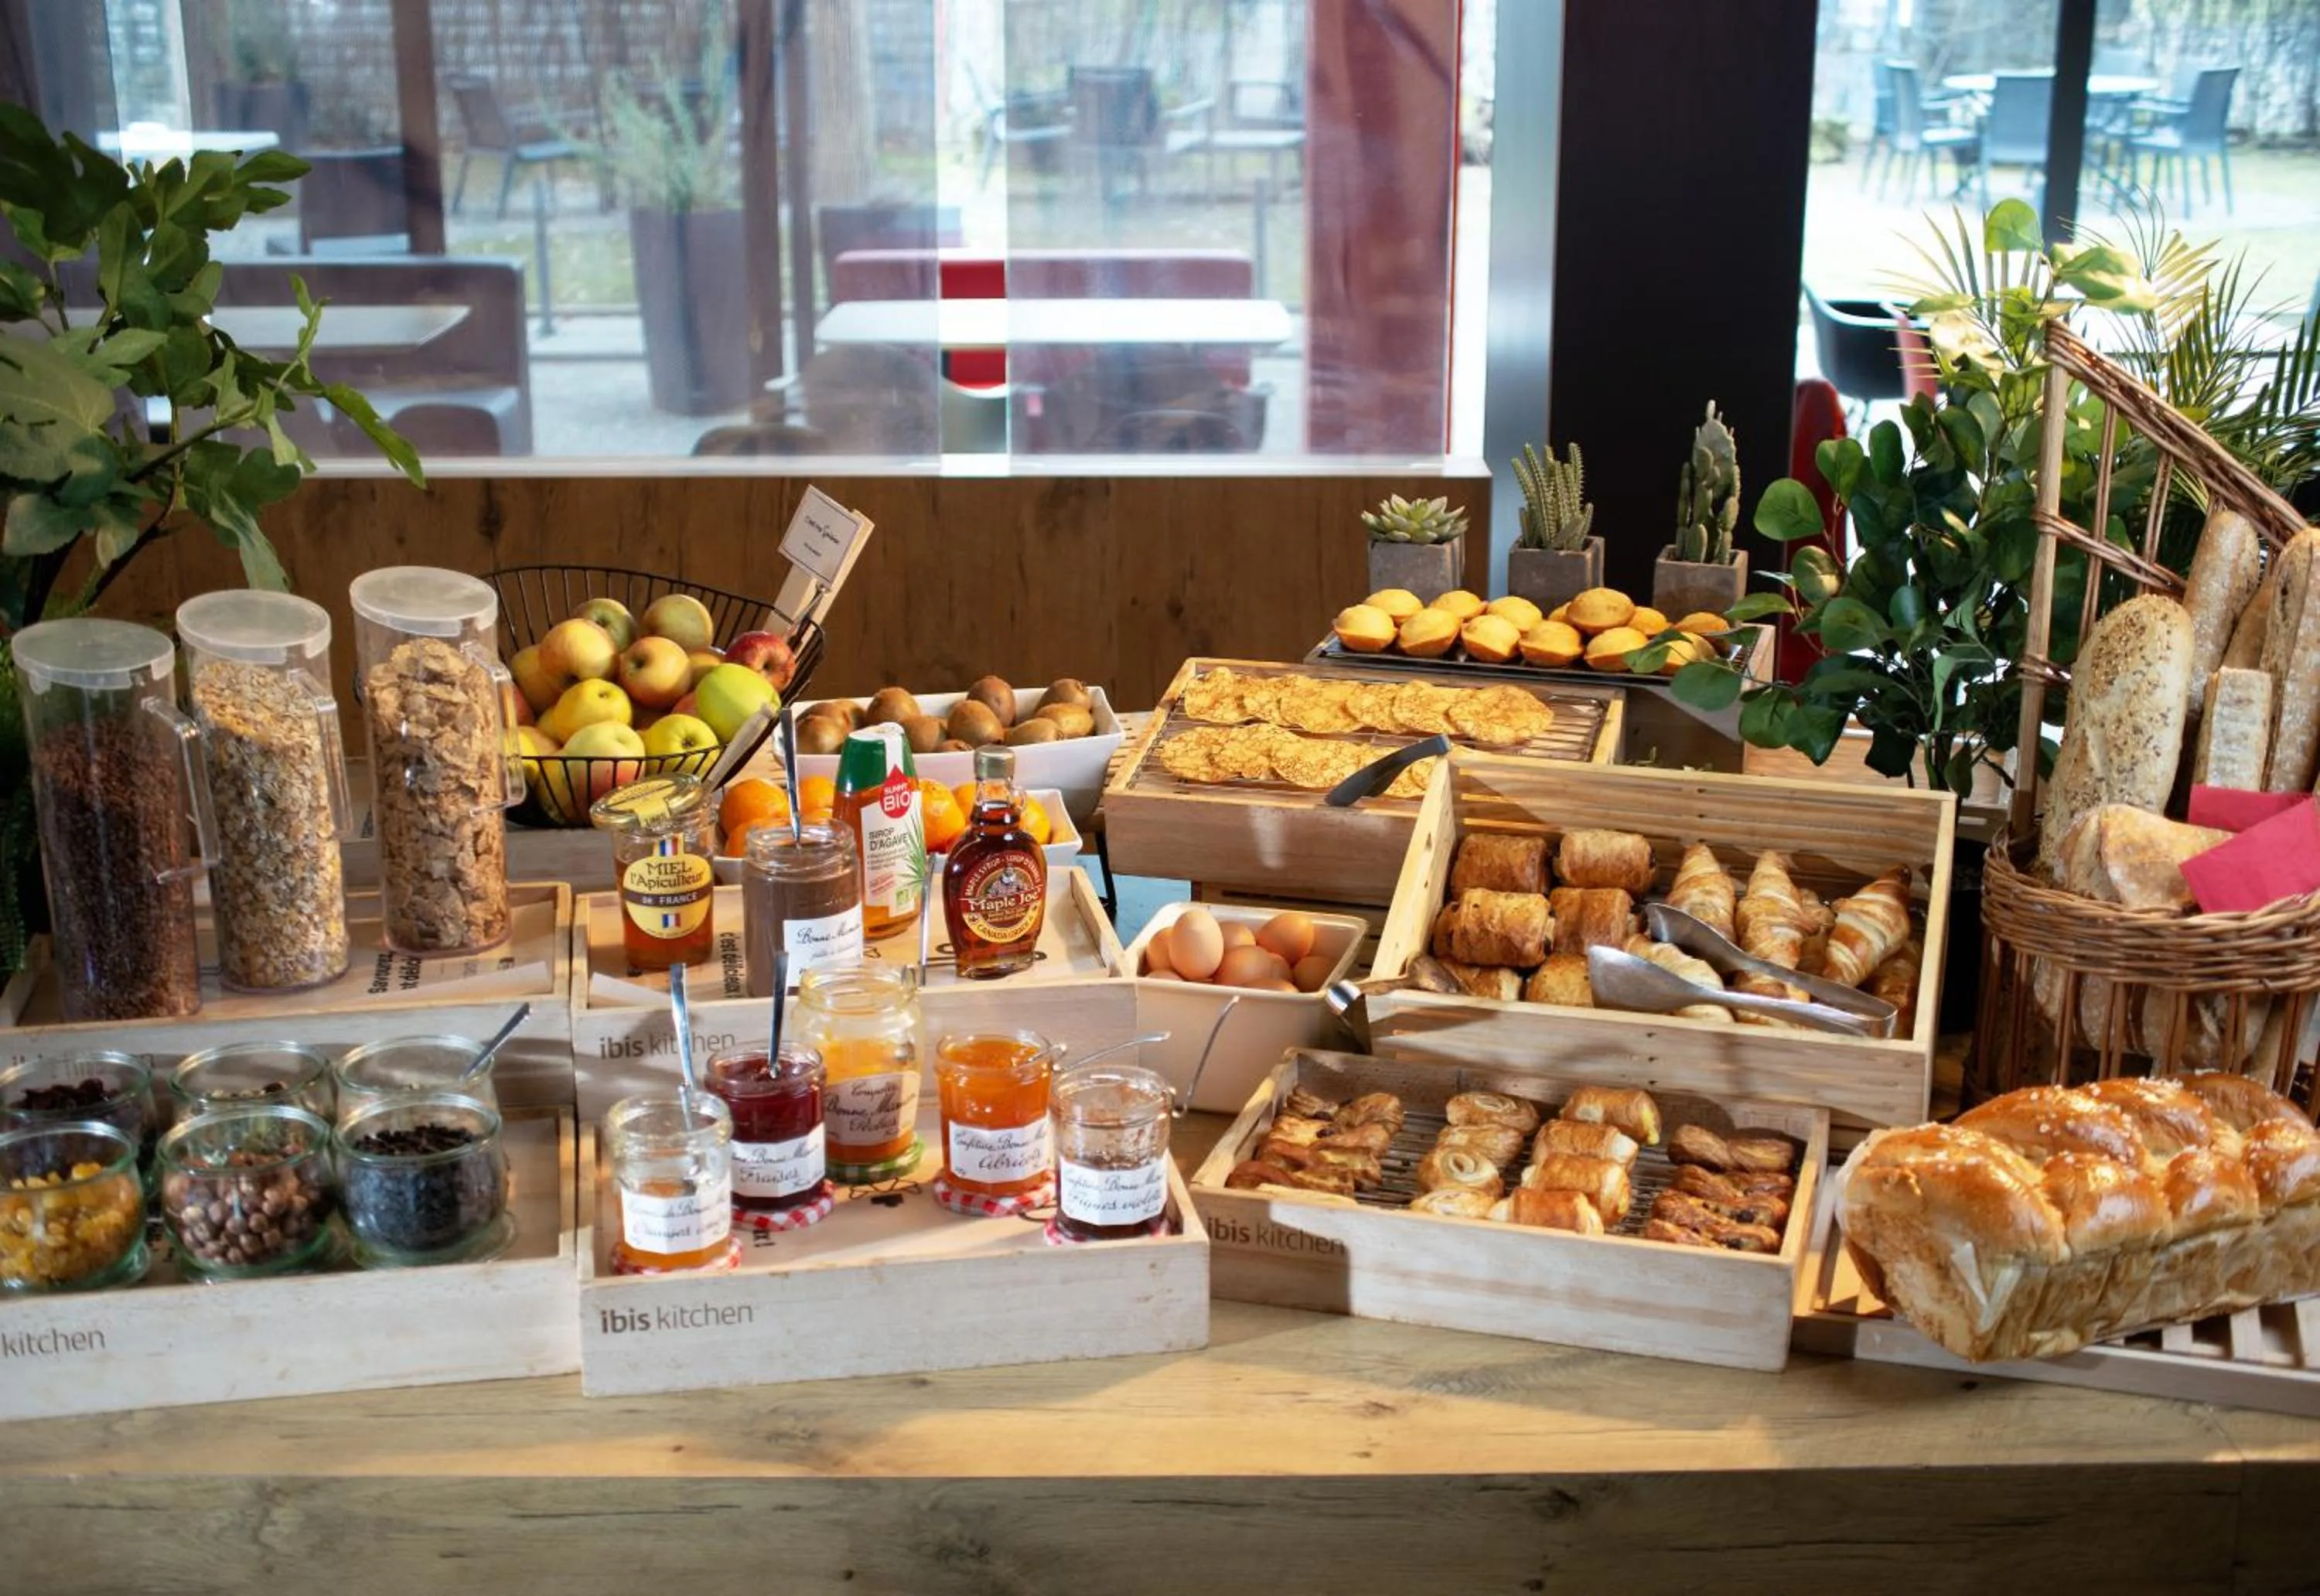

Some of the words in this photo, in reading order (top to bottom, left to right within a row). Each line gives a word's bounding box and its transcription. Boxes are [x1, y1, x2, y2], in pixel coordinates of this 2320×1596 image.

[883, 791, 910, 811] BIO
[868, 827, 895, 840] SIROP
[870, 831, 909, 851] D'AGAVE
[659, 891, 698, 905] FRANCE
[968, 897, 1016, 912] Maple
[599, 1036, 644, 1059] ibis
[650, 1032, 735, 1056] kithen
[1207, 1216, 1250, 1244] ibis
[1256, 1222, 1345, 1256] kitchen
[601, 1307, 652, 1334] ibis
[657, 1303, 754, 1330] kitchen
[1, 1327, 106, 1358] kitchen
